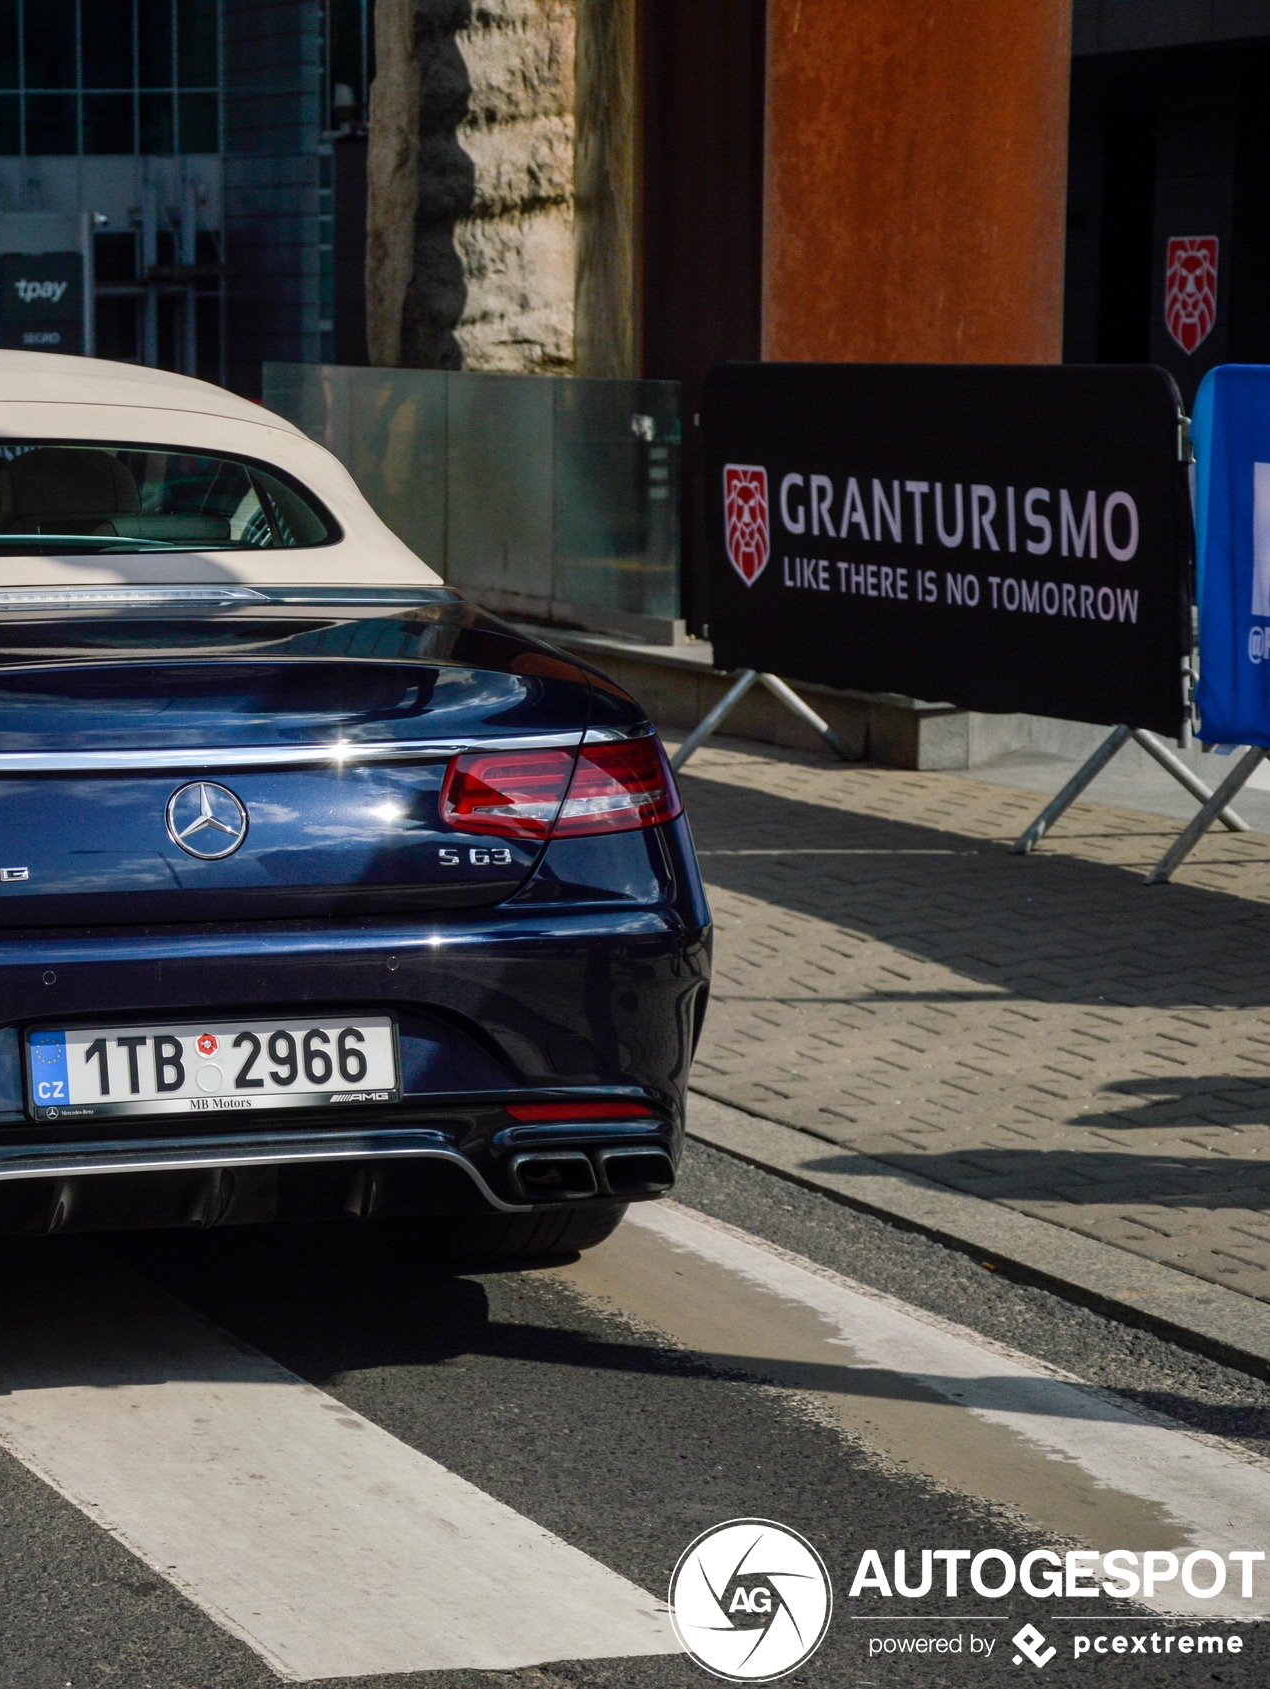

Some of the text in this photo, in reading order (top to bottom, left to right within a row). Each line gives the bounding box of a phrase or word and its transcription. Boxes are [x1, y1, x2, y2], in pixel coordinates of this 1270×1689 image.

[15, 278, 68, 302] tpay
[781, 472, 1140, 562] GRANTURISMO
[783, 556, 1140, 624] LIKE THERE IS NO TOMORROW
[438, 848, 512, 866] S 63
[84, 1027, 368, 1095] 1TB 2966
[38, 1081, 65, 1099] CZ
[347, 1092, 389, 1101] AMG
[189, 1098, 252, 1110] MB Motors
